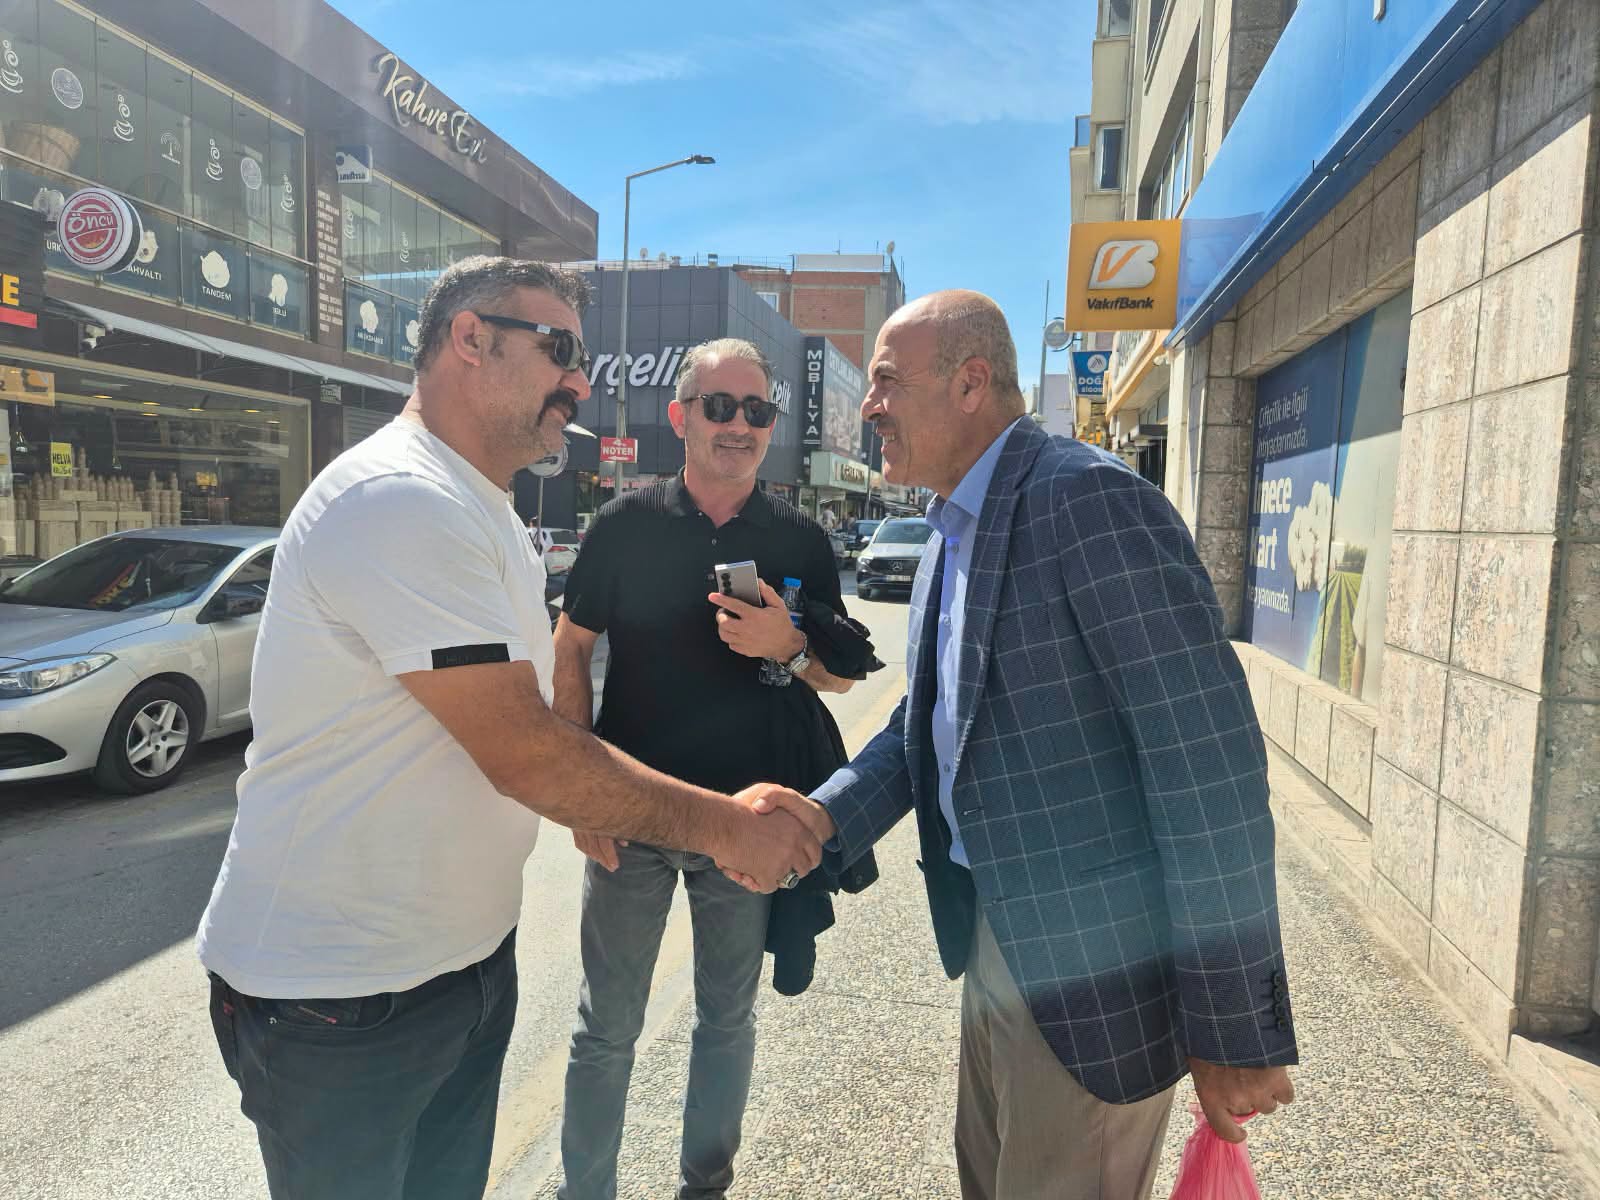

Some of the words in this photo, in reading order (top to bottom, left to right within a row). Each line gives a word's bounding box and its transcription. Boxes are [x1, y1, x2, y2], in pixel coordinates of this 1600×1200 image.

[378, 53, 448, 136] Kahve
[451, 110, 487, 164] Evi
[127, 265, 162, 280] AHVALTI
[0, 272, 20, 306] E
[202, 286, 232, 301] TANDEM
[590, 346, 687, 395] rçeli
[1078, 376, 1103, 385] DOĞ
[52, 452, 72, 464] HELVA
[602, 446, 634, 456] NOTER
